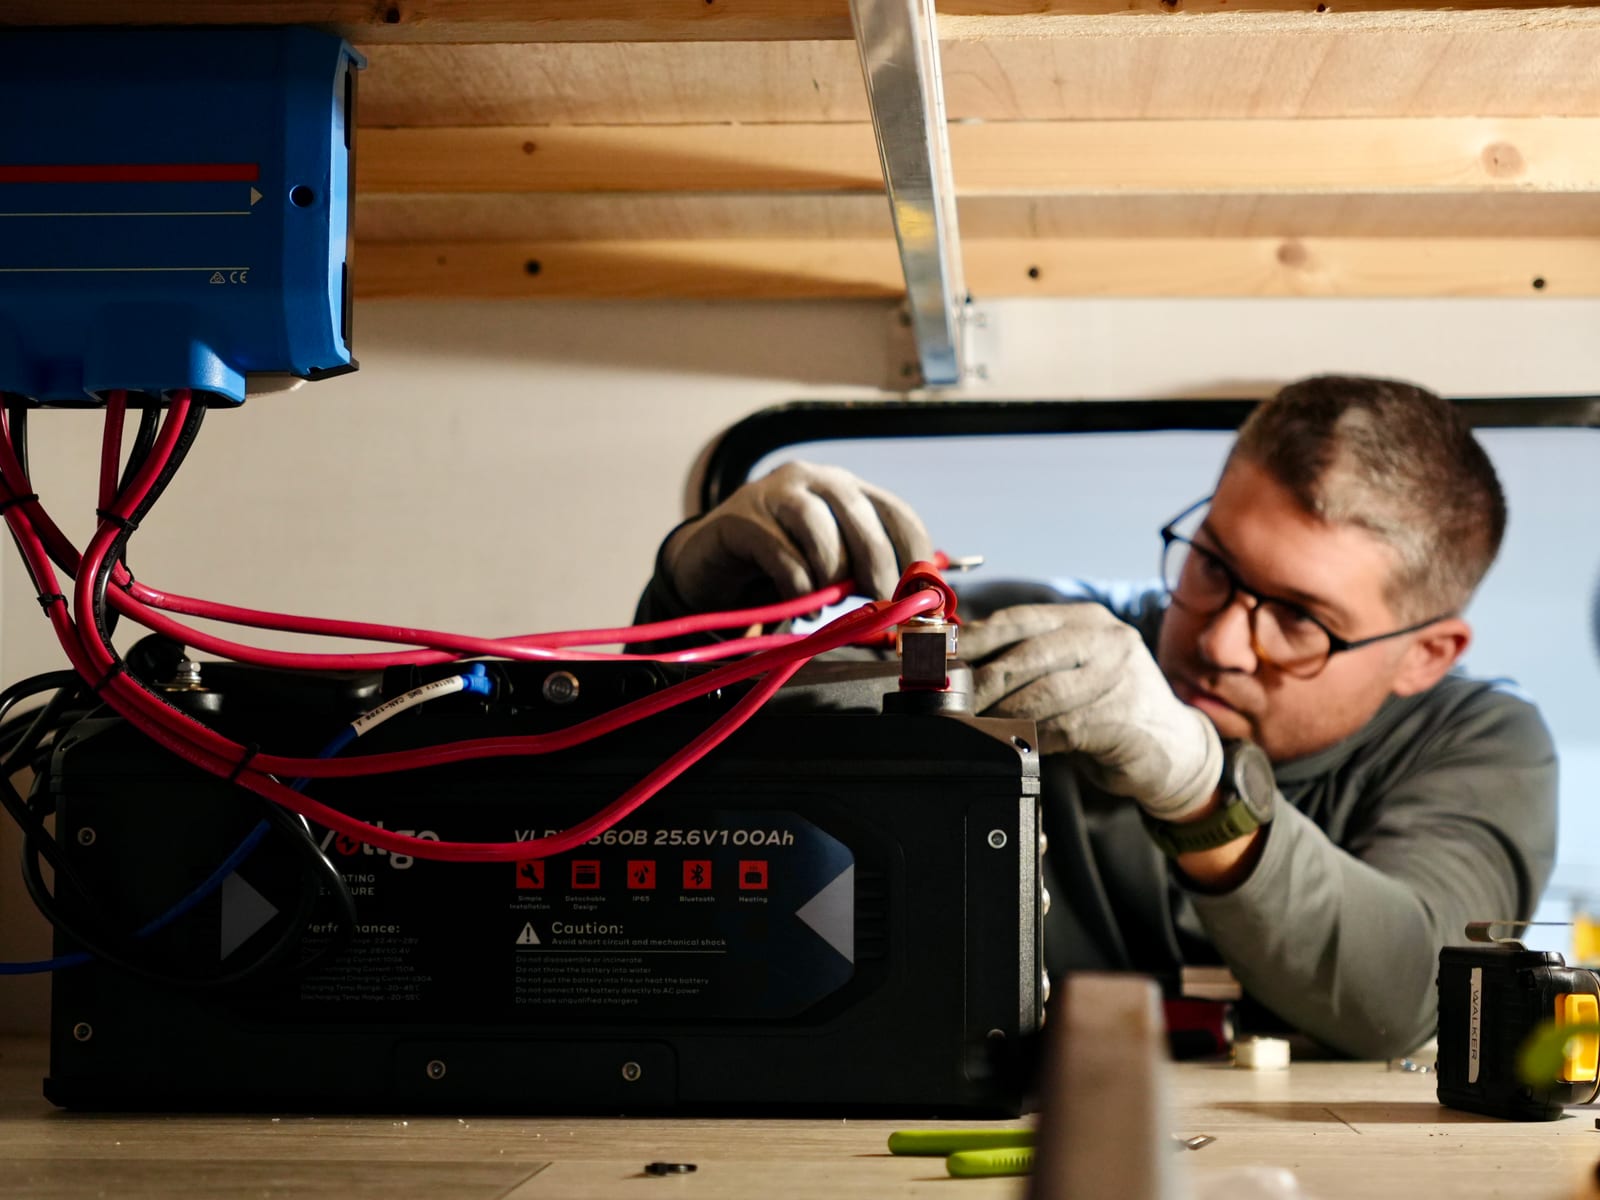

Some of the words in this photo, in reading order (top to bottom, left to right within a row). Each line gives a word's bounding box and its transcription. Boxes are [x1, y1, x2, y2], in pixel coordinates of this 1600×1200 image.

[654, 829, 795, 846] 25.6V100Ah
[679, 895, 716, 903] Bluetooth
[738, 895, 769, 904] Heating
[551, 921, 624, 934] Caution:
[551, 938, 576, 946] Avoid
[578, 938, 601, 946] short
[603, 938, 630, 946] circuit
[632, 938, 649, 946] and
[649, 938, 699, 946] mechanical
[701, 938, 726, 946] shock
[1471, 990, 1479, 1060] WALKER
